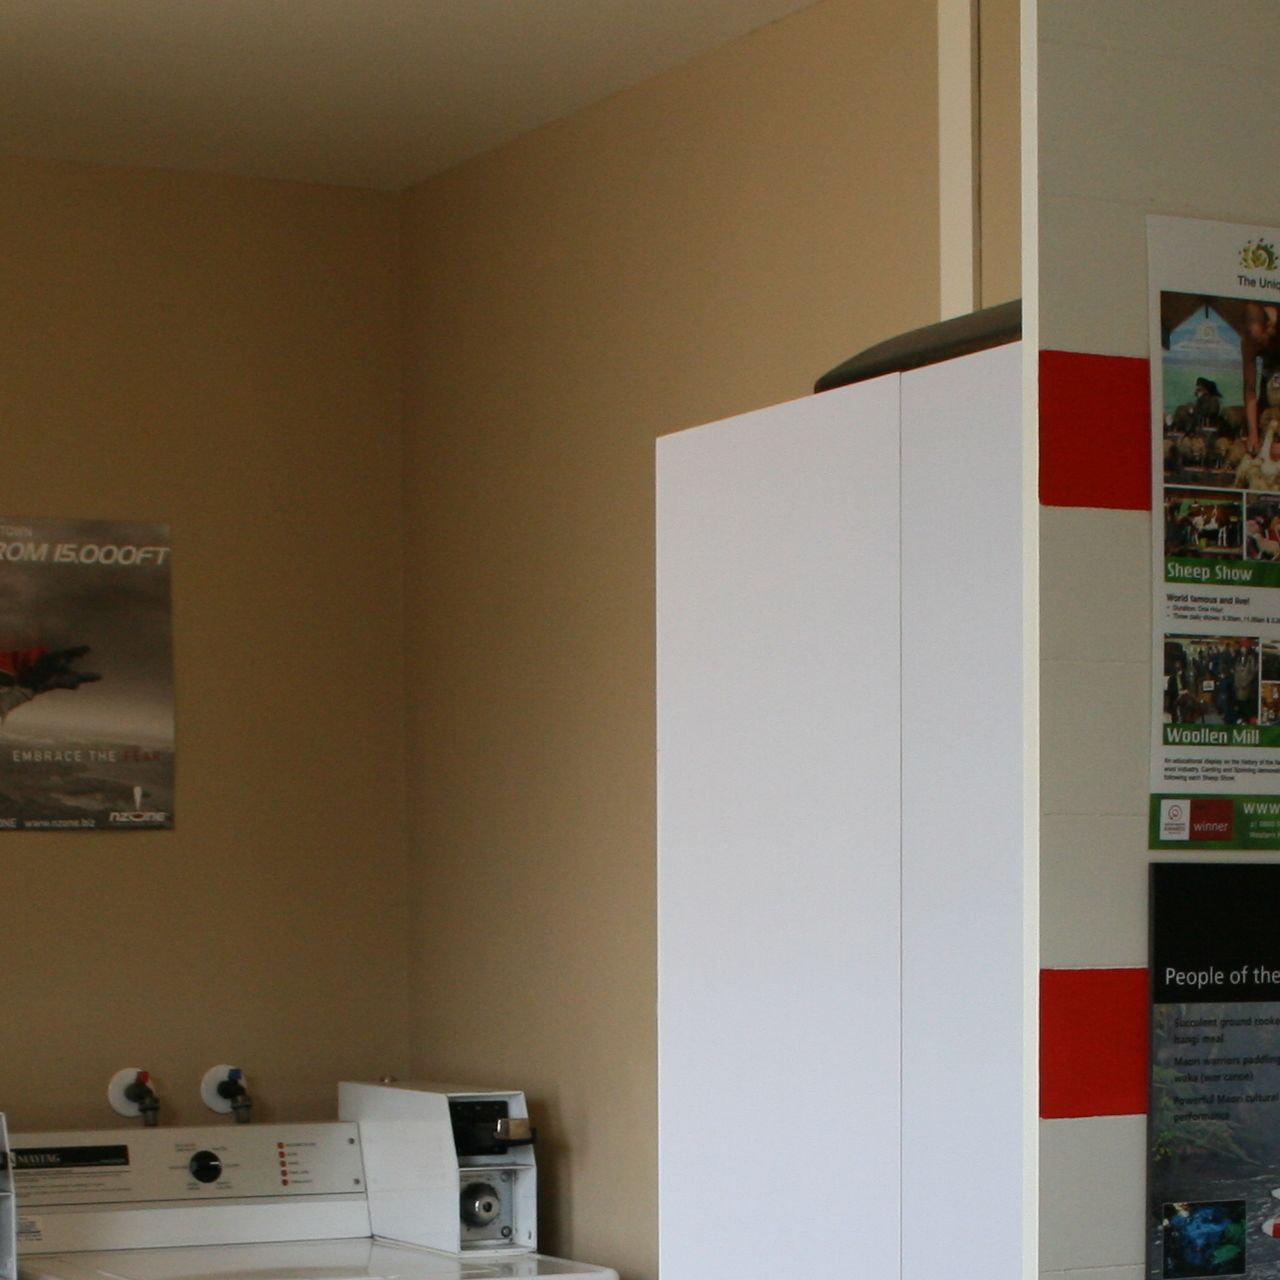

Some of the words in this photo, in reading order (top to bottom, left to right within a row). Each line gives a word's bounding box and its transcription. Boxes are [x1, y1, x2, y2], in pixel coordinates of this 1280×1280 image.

[1237, 275, 1257, 288] The
[1167, 562, 1210, 582] Sheep
[1214, 564, 1253, 582] Show
[1167, 727, 1228, 744] Woollen
[1231, 727, 1260, 745] Mill
[12, 749, 84, 763] EMBRACE
[89, 749, 118, 763] THE
[1193, 820, 1229, 833] winner
[1165, 966, 1224, 989] People
[1229, 965, 1249, 984] of
[1253, 965, 1280, 984] the
